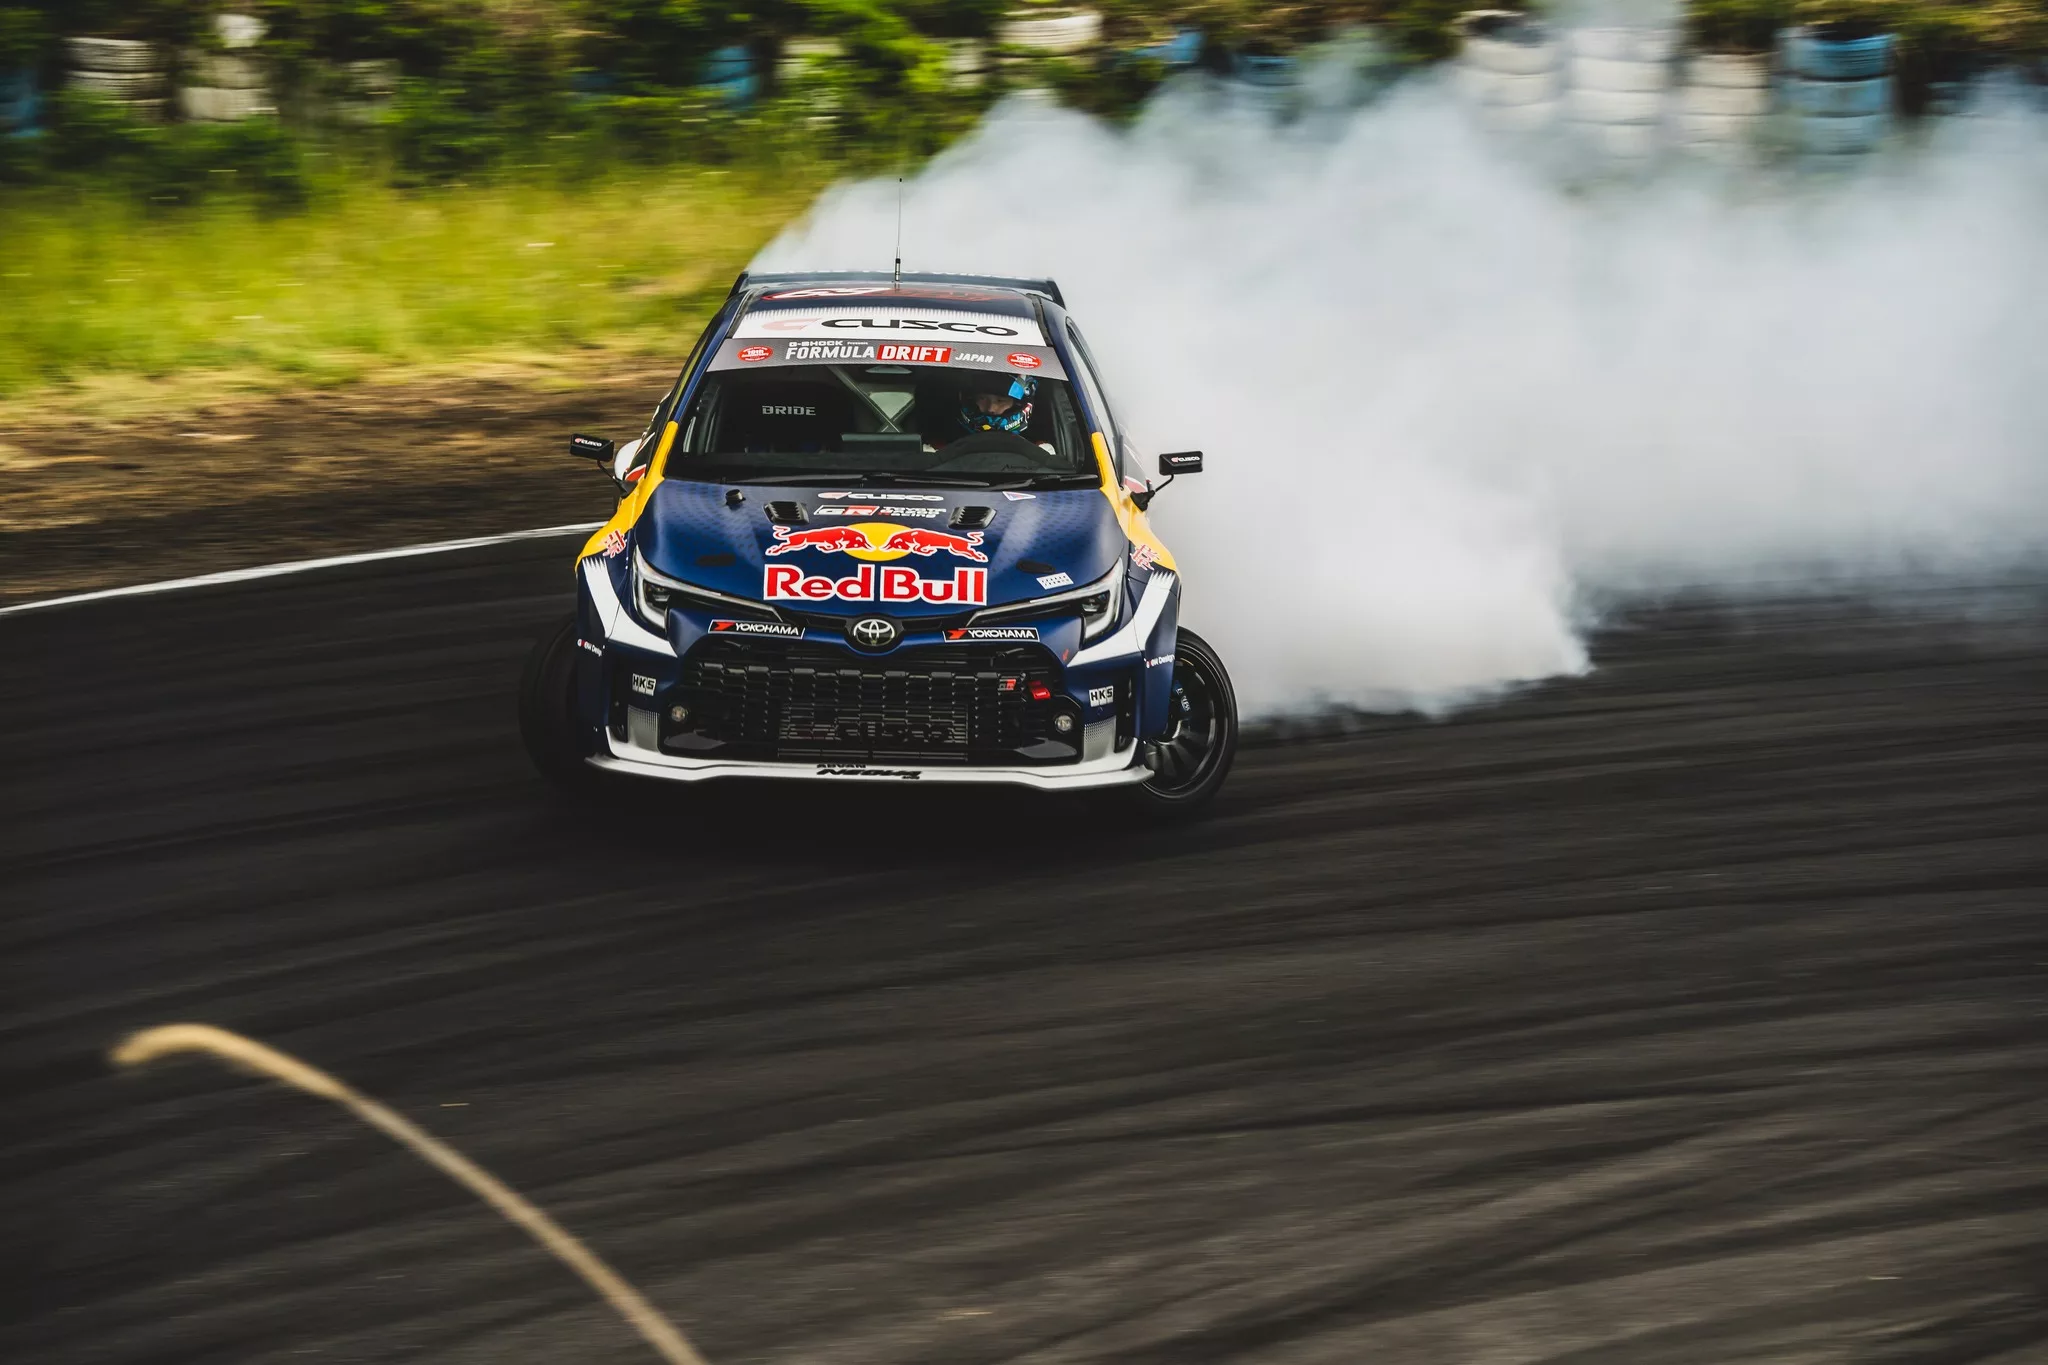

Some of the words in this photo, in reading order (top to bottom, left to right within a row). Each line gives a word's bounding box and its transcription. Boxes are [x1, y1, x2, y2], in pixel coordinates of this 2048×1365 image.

[820, 318, 1019, 337] CUSCO
[785, 345, 875, 360] FORMULA
[881, 346, 948, 362] DRIFT
[955, 352, 994, 363] JAPAN
[762, 405, 816, 416] BRIDE
[848, 493, 944, 501] CUSCO
[765, 565, 874, 600] Red
[881, 567, 987, 604] Bull
[735, 622, 799, 636] YOKOHAMA
[968, 629, 1035, 639] YOKOHAMA
[633, 674, 656, 691] HKS
[1090, 687, 1114, 702] HKS
